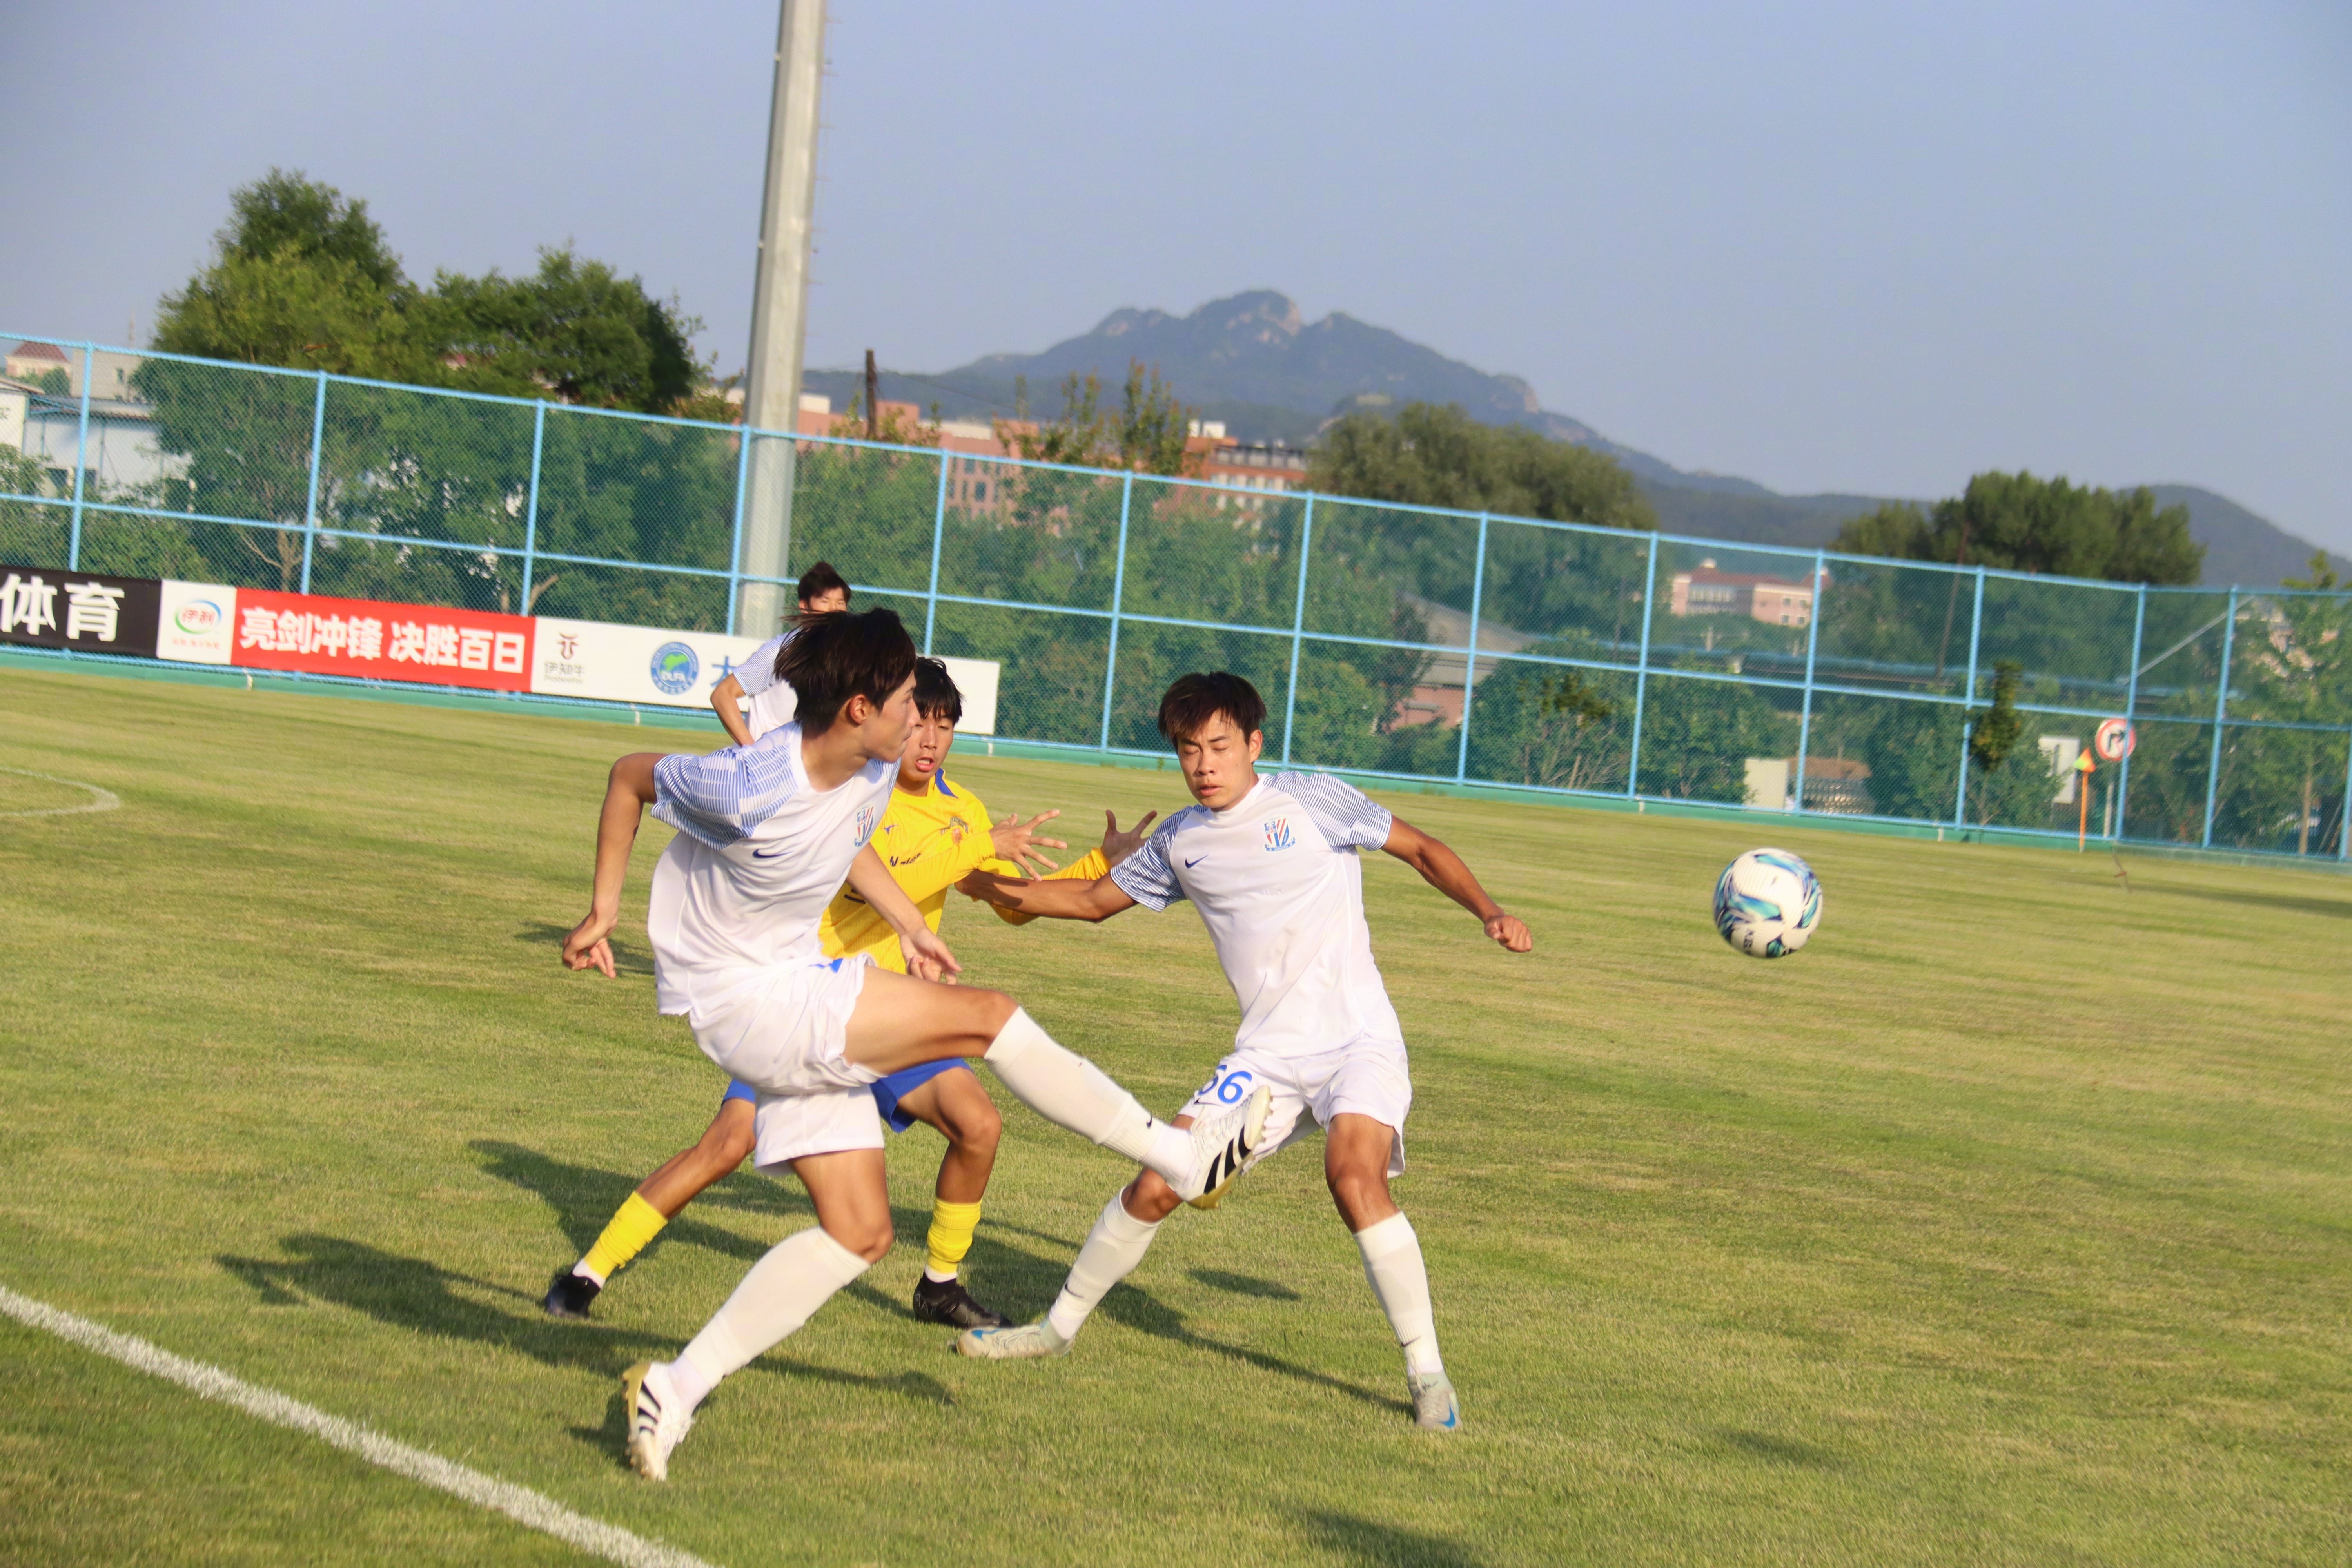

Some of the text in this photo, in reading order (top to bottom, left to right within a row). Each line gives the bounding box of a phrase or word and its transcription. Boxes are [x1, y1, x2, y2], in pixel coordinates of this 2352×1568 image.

[0, 573, 125, 642] 体育
[182, 610, 216, 625] 伊利
[240, 607, 526, 674] 亮剑冲锋 决胜百日
